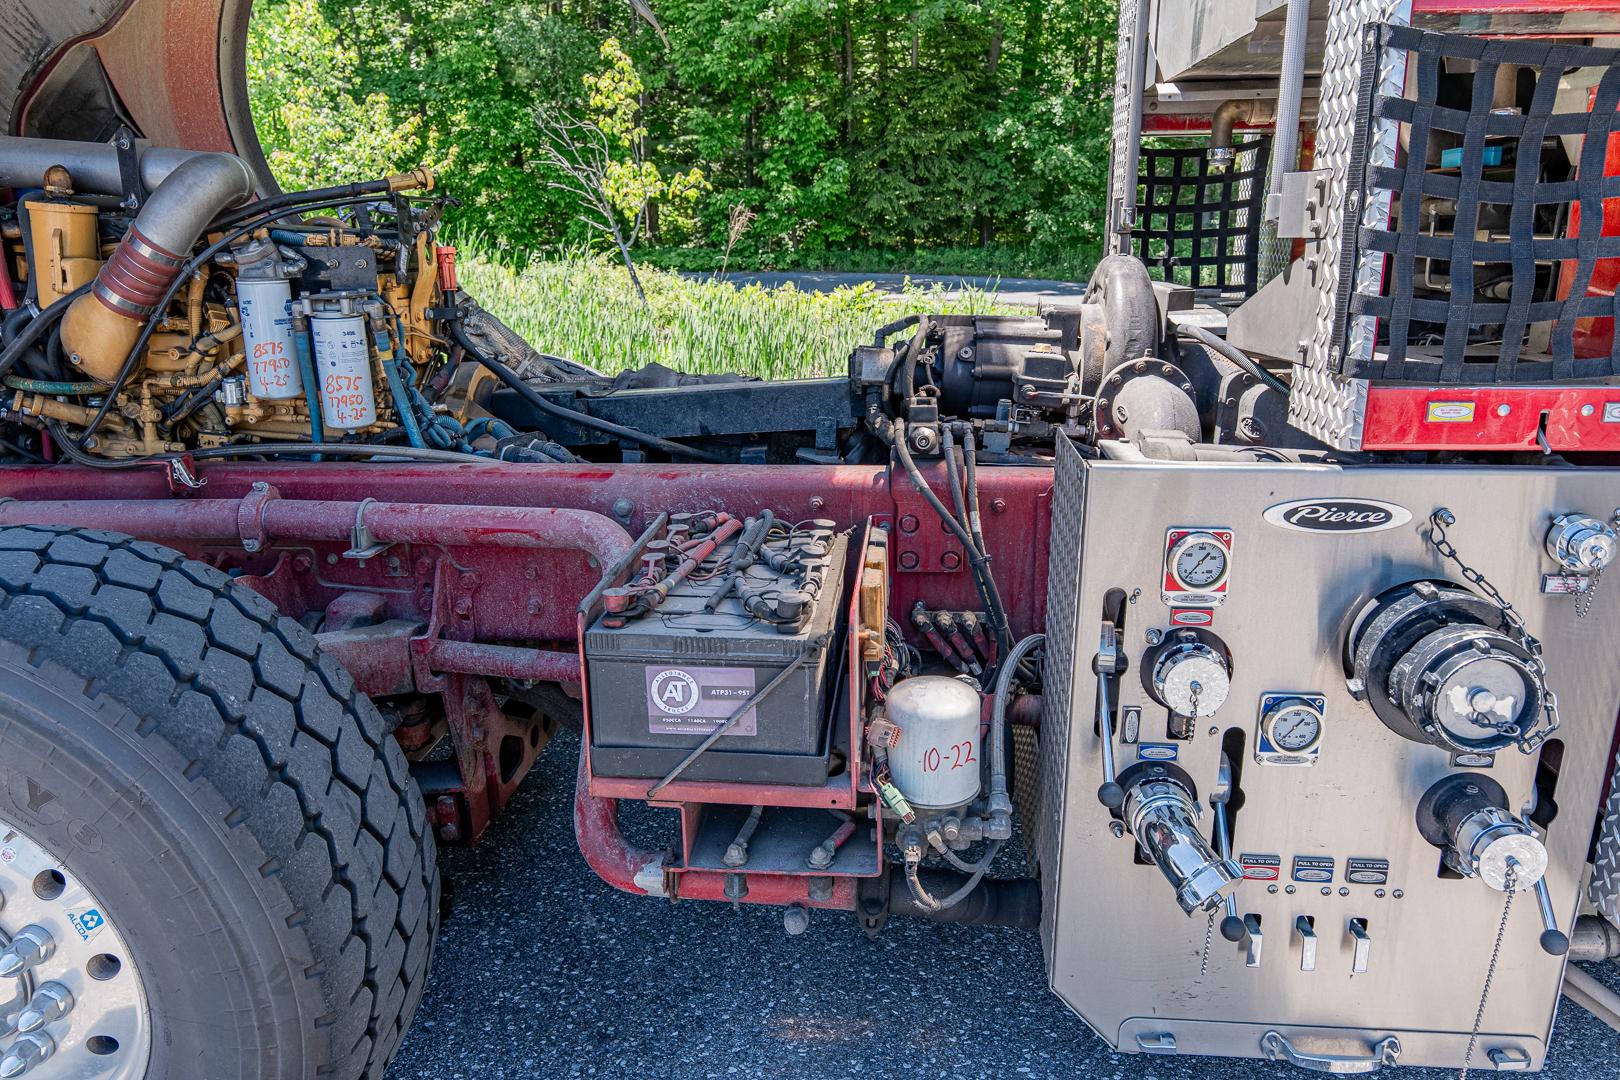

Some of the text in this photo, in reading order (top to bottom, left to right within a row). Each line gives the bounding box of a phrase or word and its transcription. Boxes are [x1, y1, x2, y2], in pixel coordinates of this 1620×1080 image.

[253, 358, 290, 374] 77950
[260, 374, 290, 391] 4-25
[326, 374, 362, 394] 8575
[328, 394, 364, 408] 77950
[337, 406, 367, 424] 4-25
[1289, 505, 1387, 524] Pierce
[655, 671, 694, 684] ALLEGIANCE
[662, 681, 687, 702] AT
[663, 705, 691, 713] TRUCKS
[923, 741, 977, 772] 10-22
[67, 912, 90, 941] ALCOA
